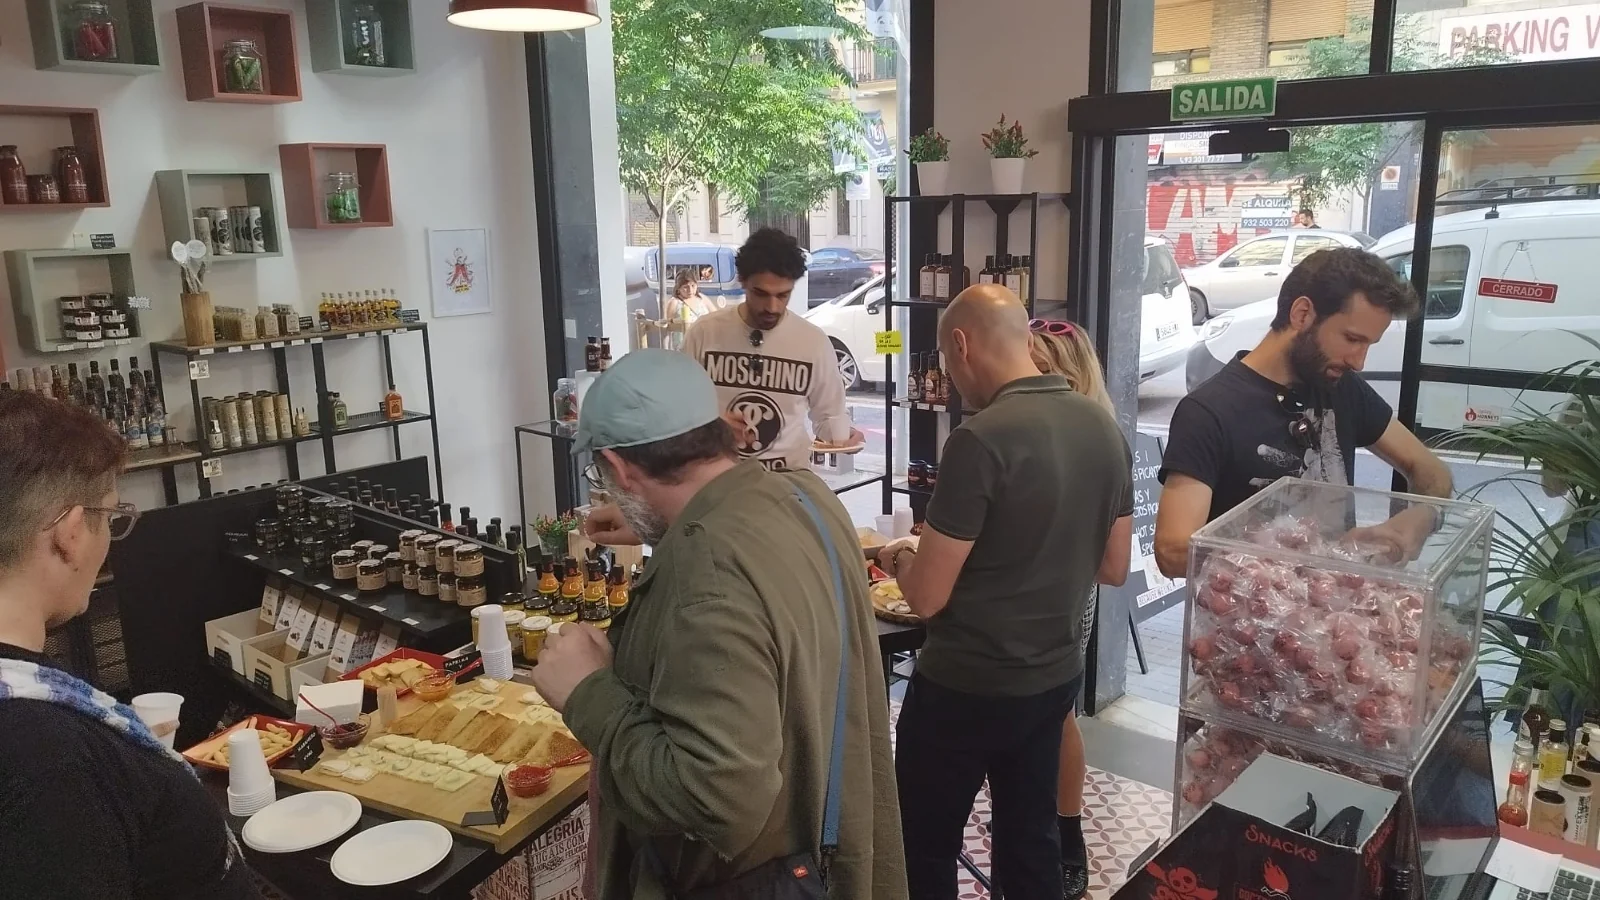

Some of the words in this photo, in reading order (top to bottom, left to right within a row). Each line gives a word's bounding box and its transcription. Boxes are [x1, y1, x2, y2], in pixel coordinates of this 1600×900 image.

[1450, 17, 1569, 59] PARKING
[1179, 84, 1266, 113] SALIDA
[1254, 197, 1292, 208] ALQUILA
[1243, 218, 1257, 228] 932
[1259, 218, 1273, 228] 503
[1275, 217, 1289, 227] 220
[1492, 283, 1543, 297] CERRADO
[706, 354, 809, 392] MOSCHINO
[528, 816, 585, 855] ALEGRIA
[1245, 824, 1318, 862] SNACKS
